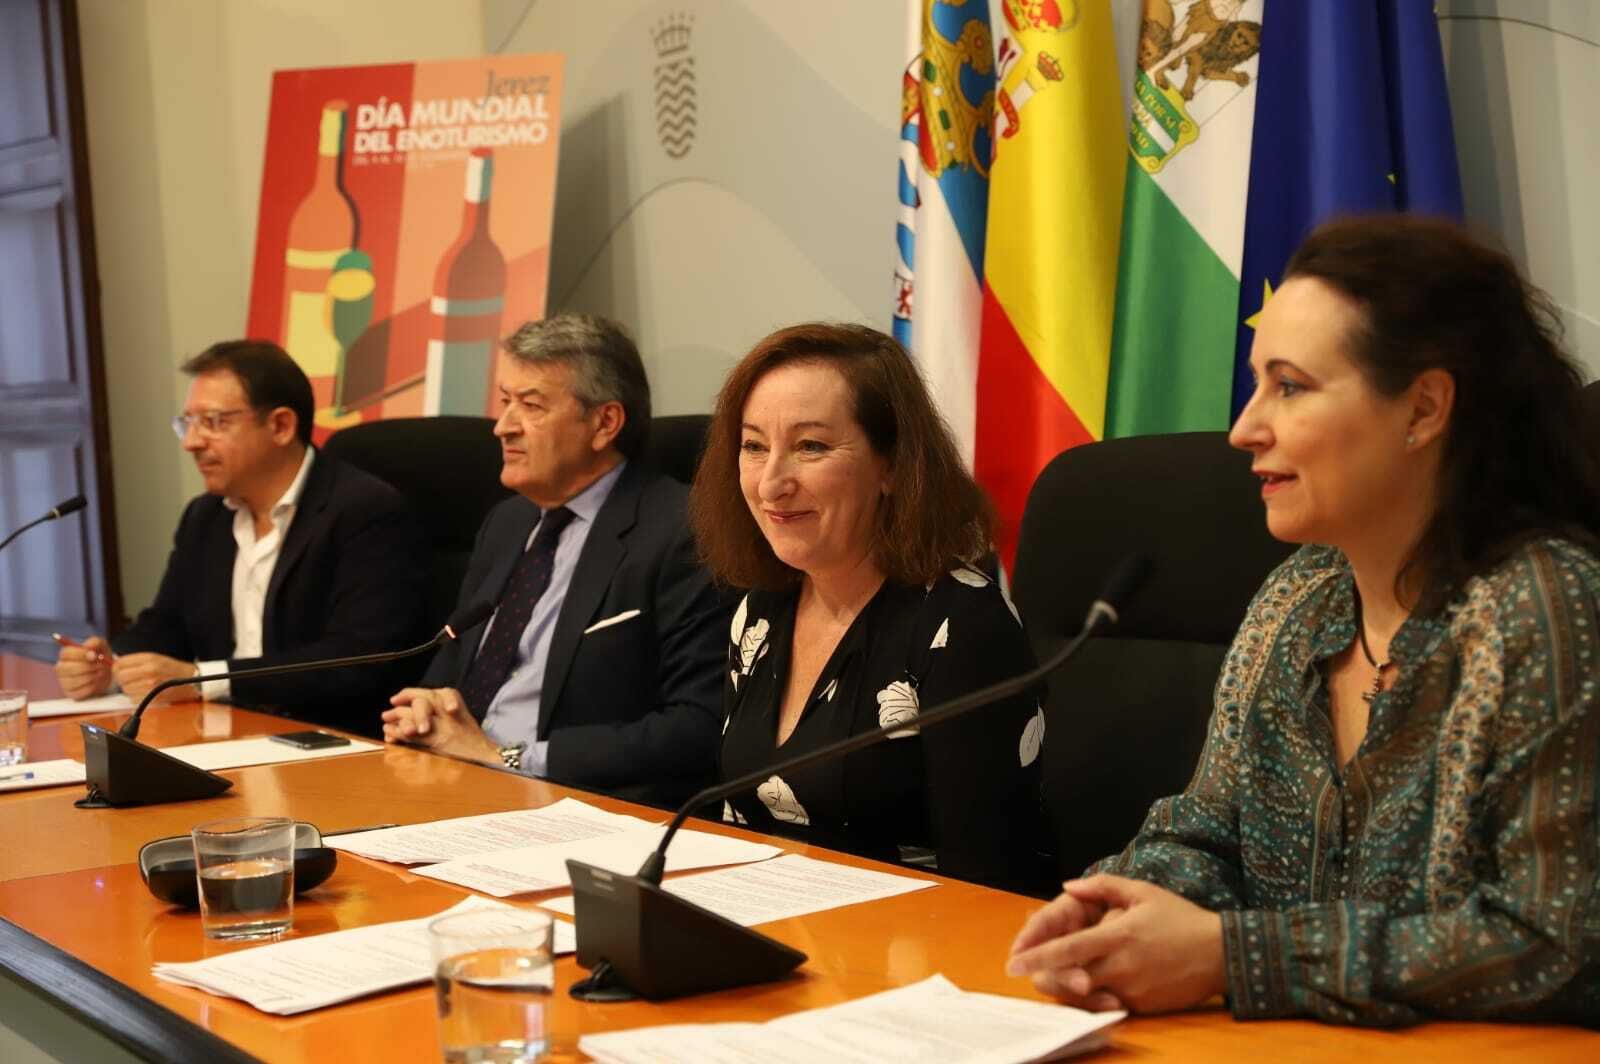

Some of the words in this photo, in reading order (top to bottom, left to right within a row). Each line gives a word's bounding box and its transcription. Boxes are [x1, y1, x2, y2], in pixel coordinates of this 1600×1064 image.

[356, 95, 406, 130] DÍA
[409, 93, 547, 127] MUNDIAL
[353, 130, 393, 154] DEL
[395, 121, 548, 150] ENOTURISMO
